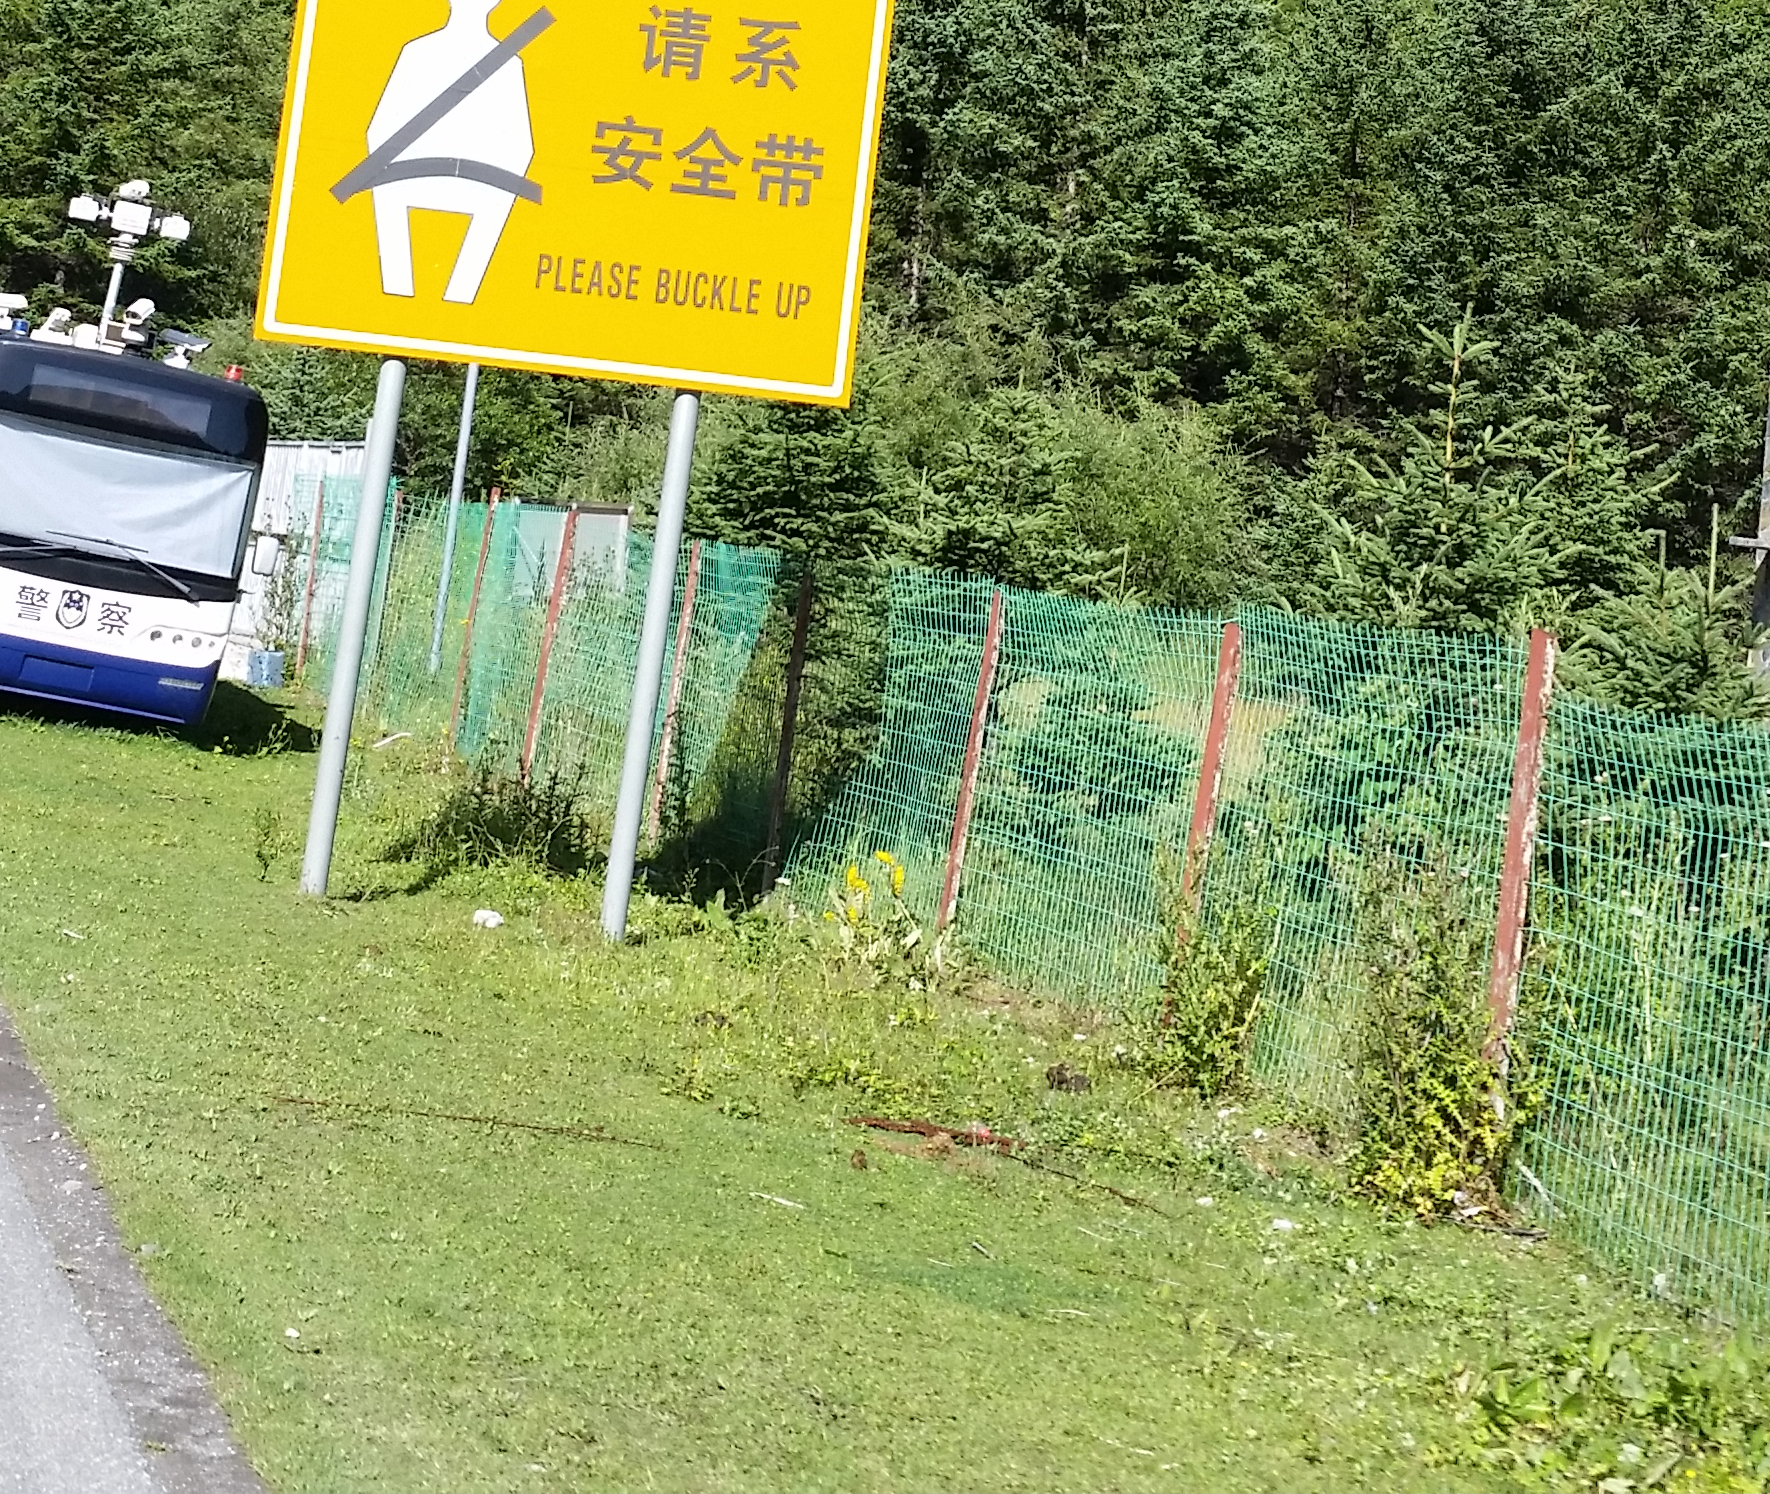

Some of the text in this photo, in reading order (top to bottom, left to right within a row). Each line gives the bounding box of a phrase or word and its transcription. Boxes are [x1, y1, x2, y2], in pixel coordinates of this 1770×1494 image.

[638, 4, 802, 92] 请系
[590, 115, 825, 208] 安全带
[535, 253, 812, 321] PLEASE BUCKLE UP
